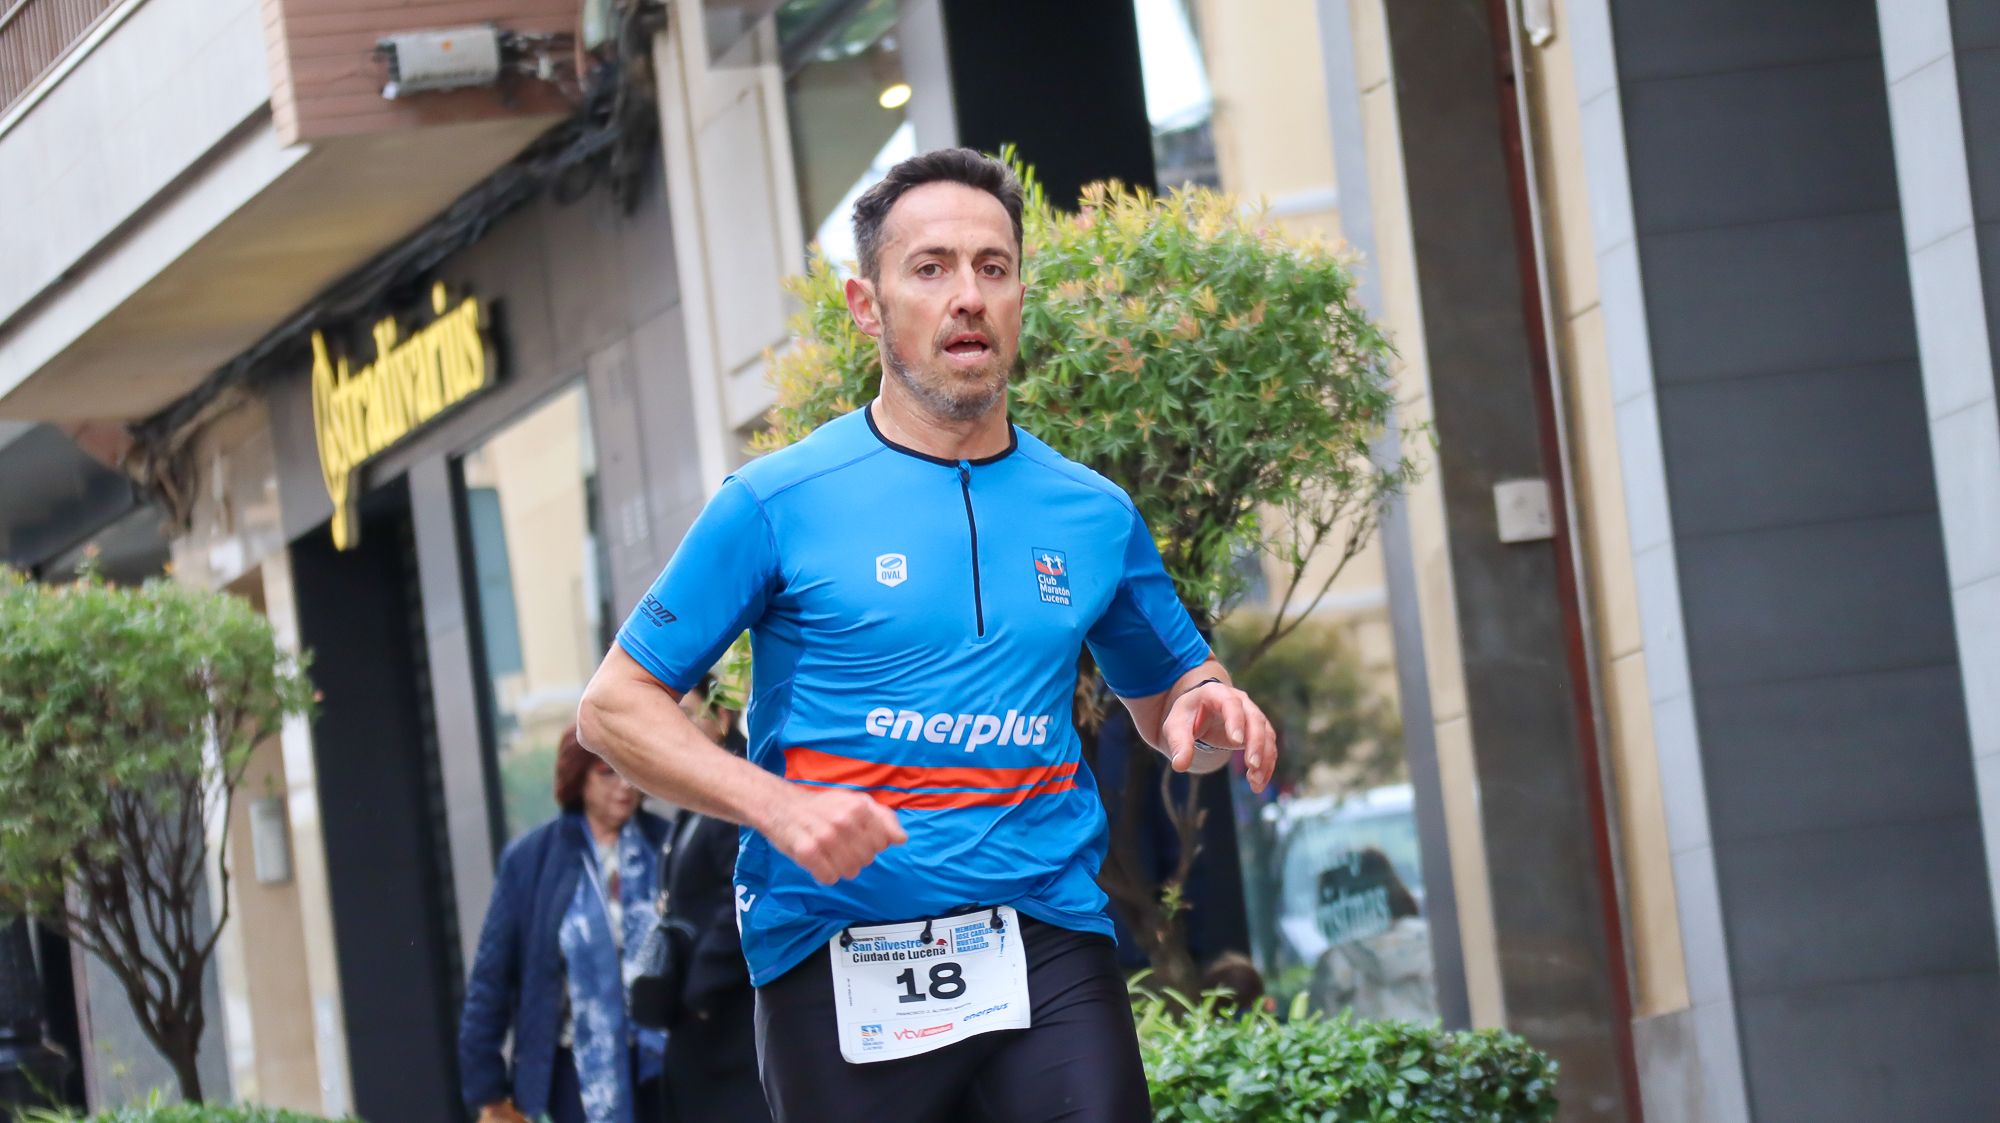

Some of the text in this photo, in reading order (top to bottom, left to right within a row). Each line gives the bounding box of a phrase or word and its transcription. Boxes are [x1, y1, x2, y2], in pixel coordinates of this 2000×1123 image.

[311, 280, 485, 551] Stradivarius
[881, 570, 902, 580] OVAL
[1038, 574, 1057, 586] Club
[1040, 583, 1071, 598] Maratón
[1041, 591, 1070, 605] Lucena
[865, 707, 1050, 752] enerplus
[853, 942, 872, 952] San
[874, 939, 922, 951] Silvestre
[852, 948, 947, 963] Ciudad de Lucena
[896, 962, 967, 1003] 18
[963, 1002, 1009, 1021] enerplus
